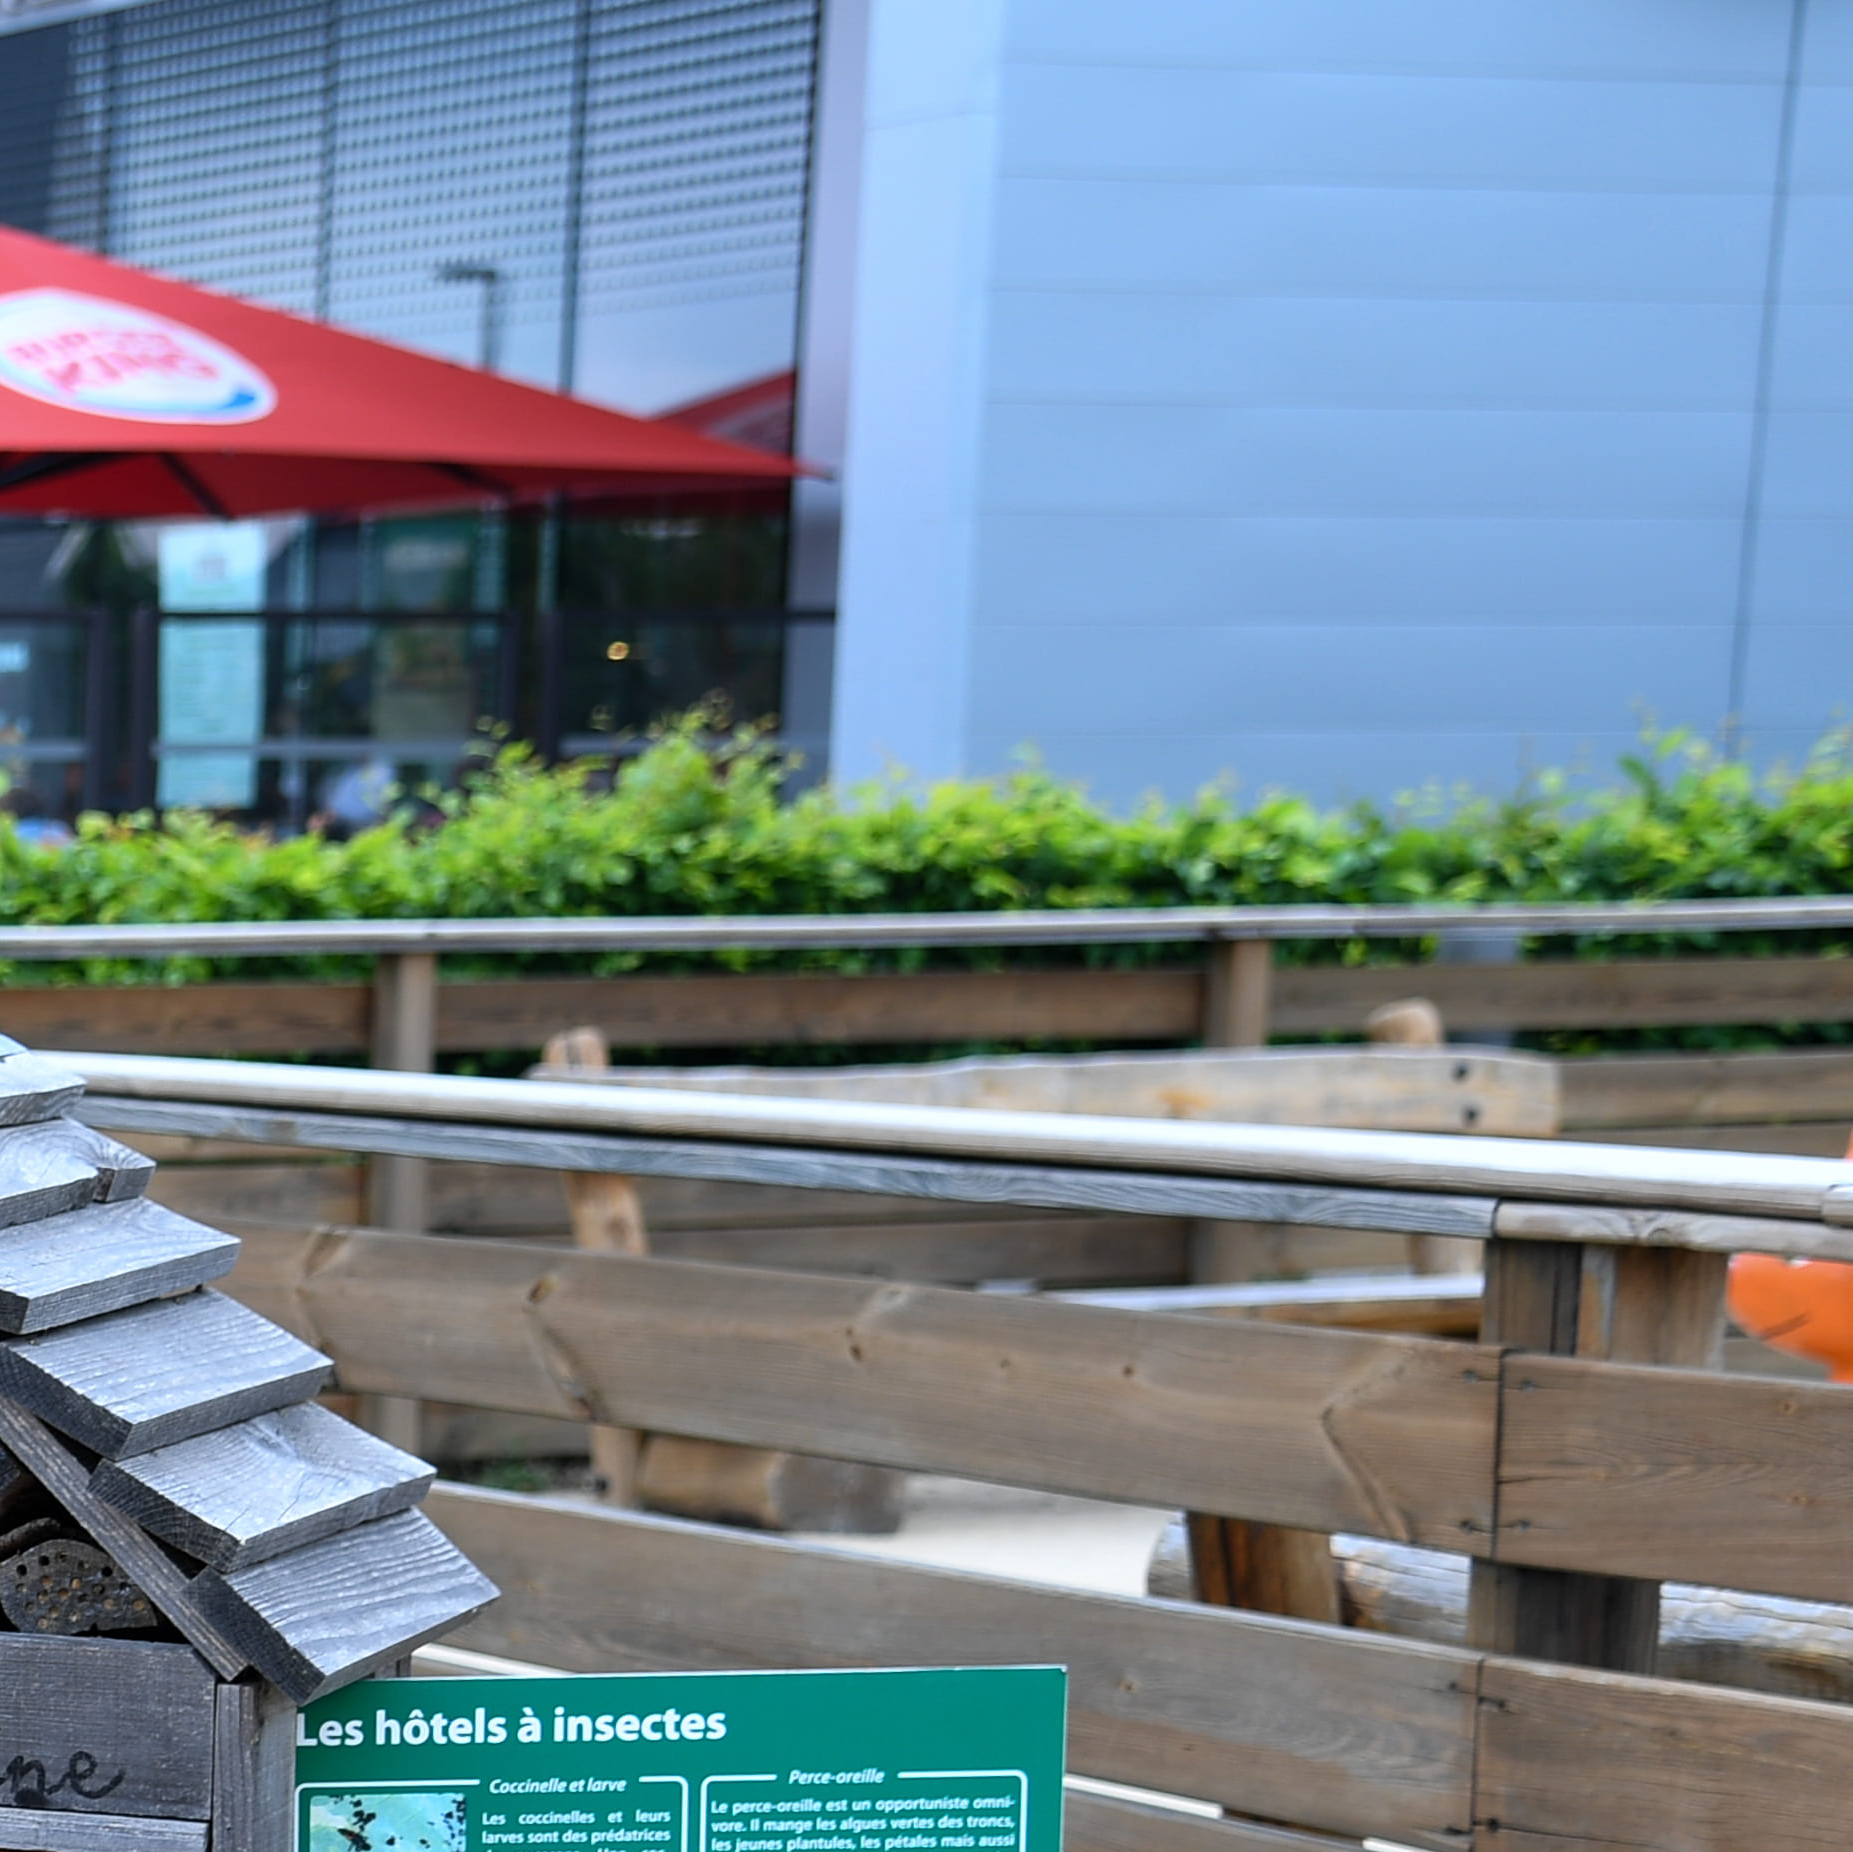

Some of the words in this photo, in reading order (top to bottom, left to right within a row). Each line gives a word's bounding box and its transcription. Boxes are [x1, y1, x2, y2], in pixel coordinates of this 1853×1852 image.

[296, 1712, 363, 1746] Les
[376, 1707, 506, 1744] hôtels
[518, 1707, 540, 1742] à
[554, 1705, 726, 1741] insectes
[789, 1768, 884, 1784] Perce-oreille
[489, 1778, 567, 1793] Coccinelle
[569, 1779, 585, 1792] et
[587, 1777, 626, 1791] larve
[711, 1801, 727, 1813] Le
[732, 1798, 821, 1815] perce-oreille
[825, 1800, 847, 1811] est
[852, 1800, 871, 1810] un
[875, 1797, 968, 1813] opportuniste
[482, 1812, 505, 1824] Les
[518, 1810, 595, 1824] coccinelles
[607, 1811, 622, 1822] et
[635, 1809, 670, 1822] leurs
[750, 1818, 759, 1830] Il
[763, 1820, 812, 1834] mange
[816, 1817, 836, 1830] les
[840, 1816, 886, 1833] algues
[890, 1817, 934, 1829] vertes
[937, 1815, 963, 1828] des
[482, 1830, 523, 1843] larves
[528, 1832, 558, 1843] sont
[562, 1829, 587, 1842] des
[591, 1828, 671, 1844] prédatrices
[711, 1838, 731, 1851] les
[735, 1838, 782, 1852] jeunes
[860, 1835, 880, 1848] les
[885, 1834, 936, 1850] pétales
[941, 1834, 974, 1847] mais
[979, 1834, 1014, 1846] aussi
